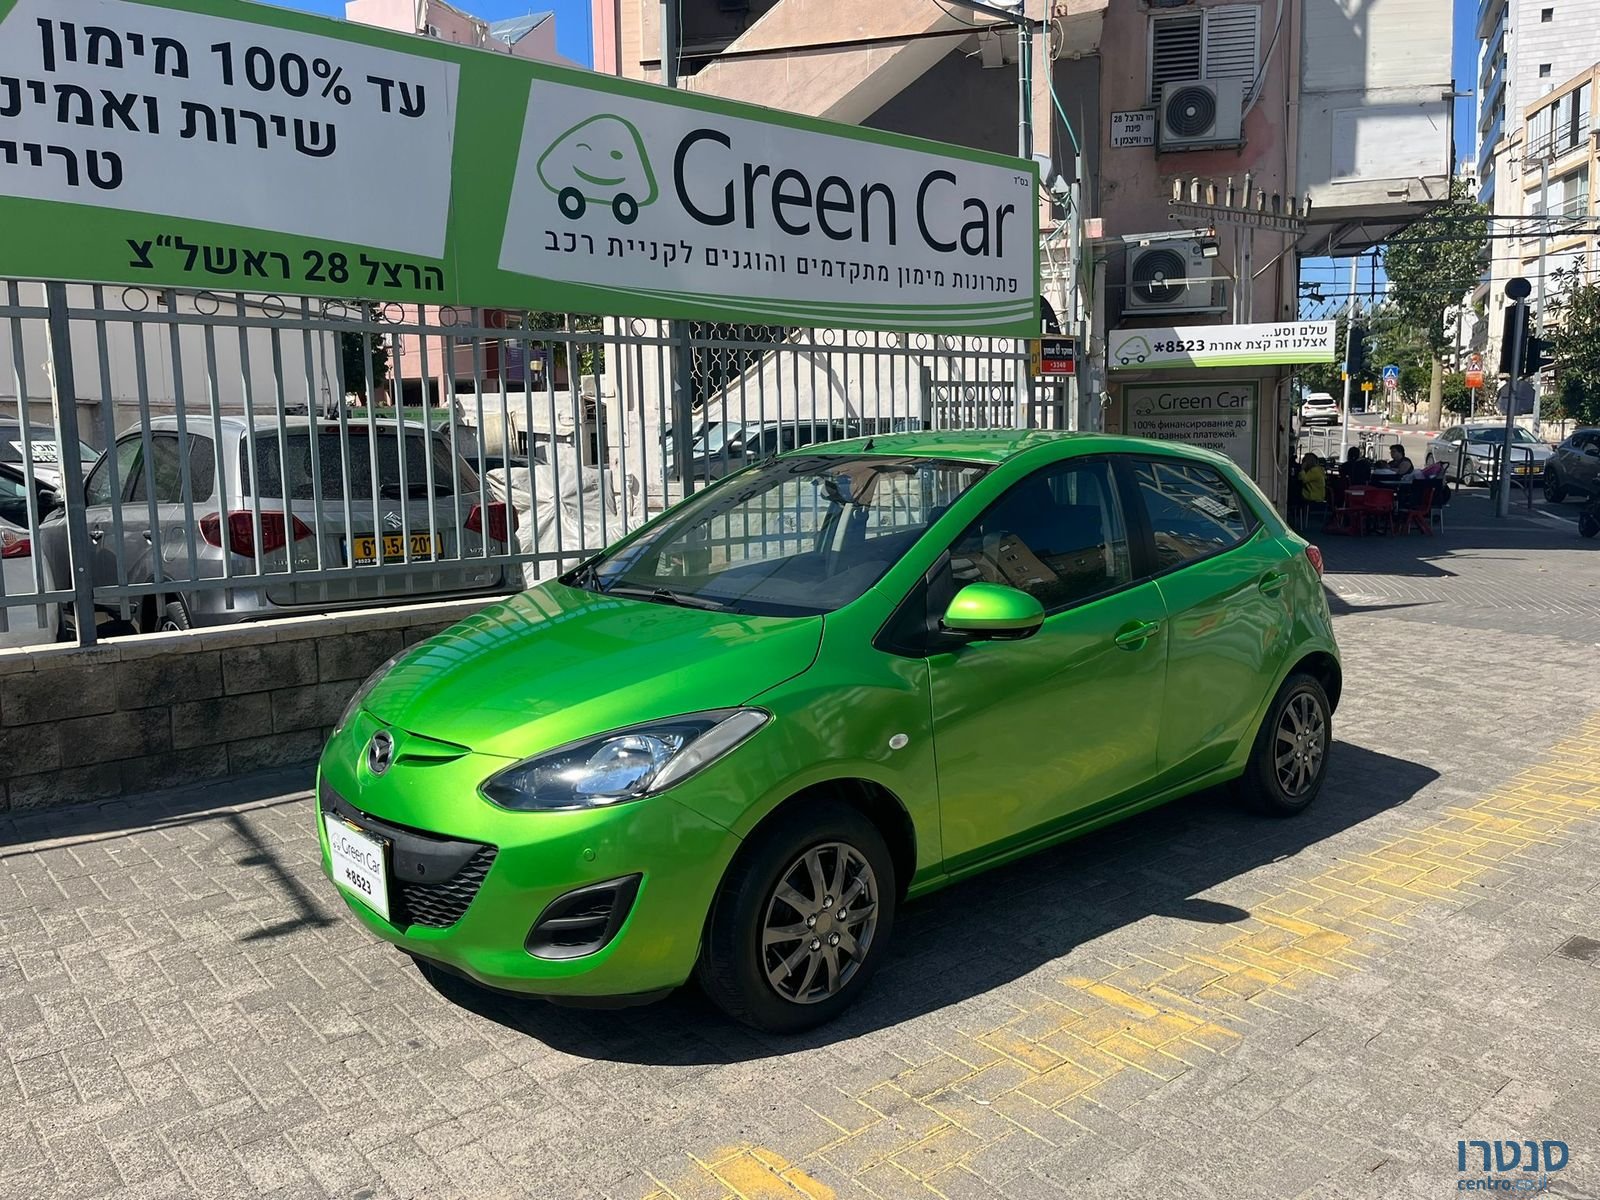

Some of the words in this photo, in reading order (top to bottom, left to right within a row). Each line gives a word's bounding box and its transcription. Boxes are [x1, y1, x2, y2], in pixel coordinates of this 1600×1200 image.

[36, 17, 189, 79] מימון
[211, 41, 352, 105] 100%
[367, 75, 426, 118] עד
[1114, 115, 1122, 123] 28
[1125, 113, 1144, 122] הרצל
[1125, 124, 1141, 132] פינת
[180, 100, 337, 158] שירות
[673, 128, 898, 246] Green
[915, 169, 1016, 258] Car
[544, 229, 595, 255] רכב
[607, 235, 694, 268] לקניית
[303, 249, 349, 284] 28
[705, 246, 786, 275] והוגנים
[796, 254, 890, 286] מתקדמים
[360, 253, 445, 291] הרצל
[897, 264, 945, 288] מימון
[951, 272, 1018, 293] פתרונות
[1262, 328, 1295, 338] וסע...
[1300, 325, 1328, 336] שלם
[1210, 342, 1242, 351] אחרת
[1246, 341, 1271, 351] קצת
[1276, 340, 1288, 348] זה
[1292, 337, 1327, 347] אצלנו
[1158, 394, 1212, 410] Green
[1217, 392, 1248, 408] Car
[1133, 420, 1156, 430] 100%
[1158, 420, 1234, 430] финансирование
[1235, 420, 1246, 428] до
[1192, 430, 1237, 438] платежей.
[341, 837, 366, 867] Green
[366, 852, 380, 875] Car
